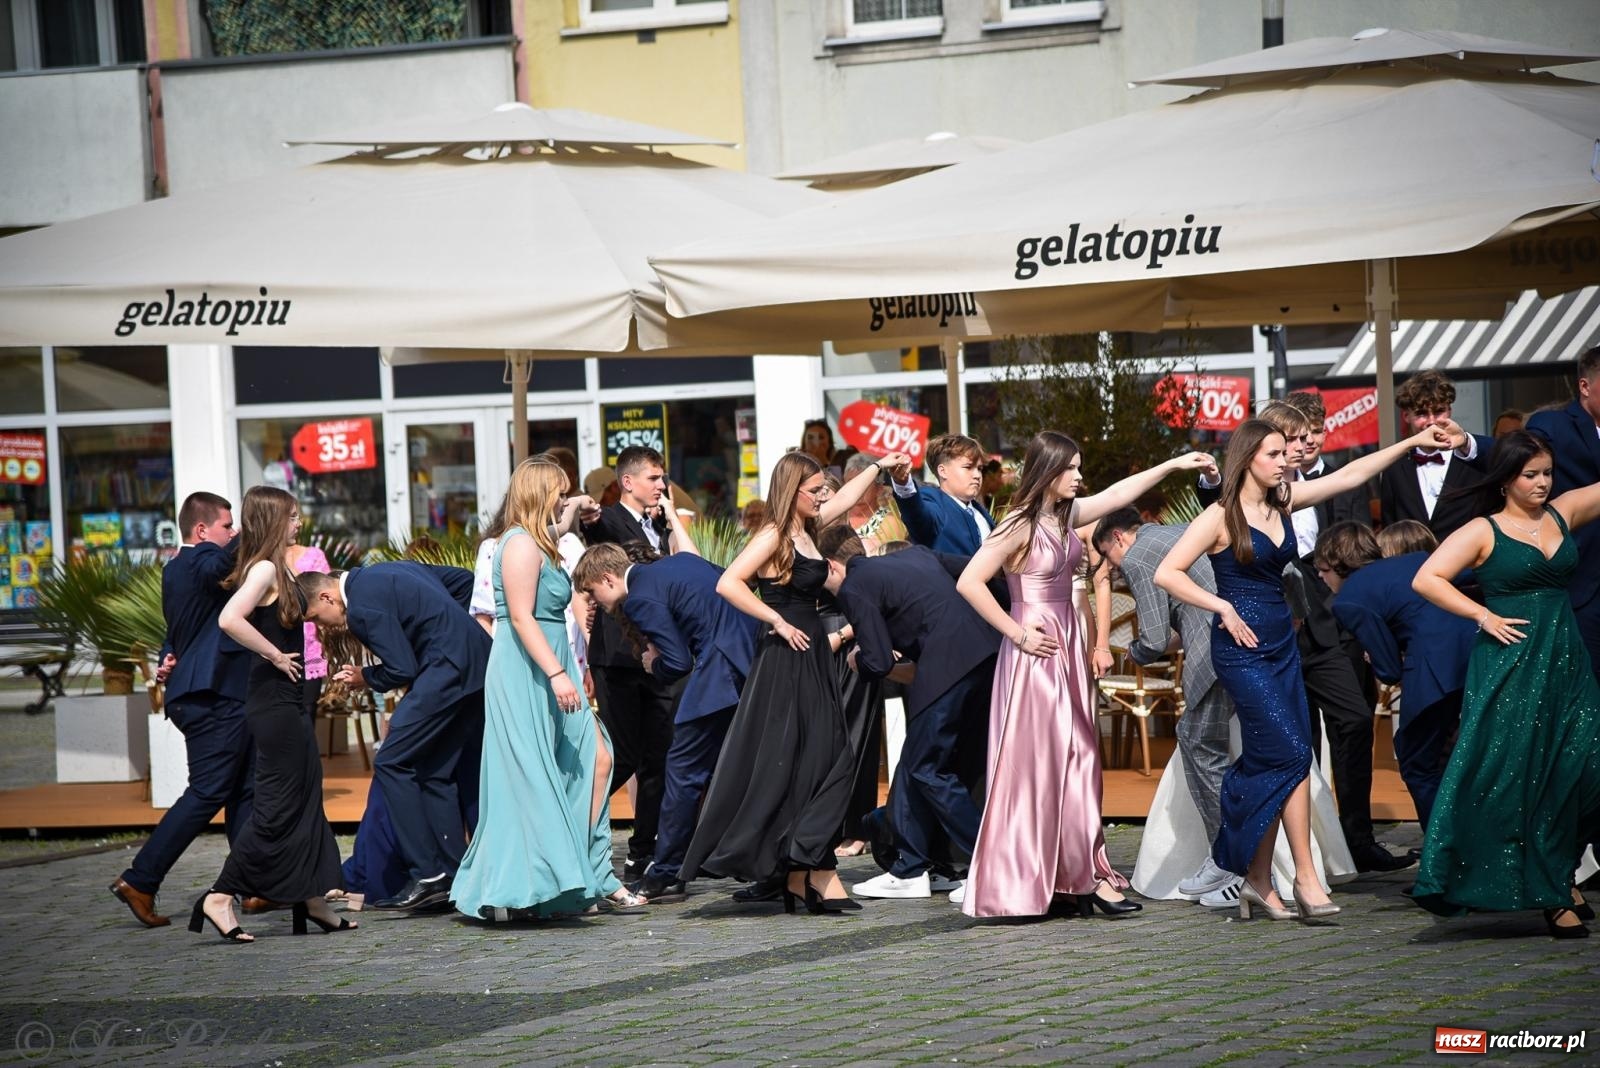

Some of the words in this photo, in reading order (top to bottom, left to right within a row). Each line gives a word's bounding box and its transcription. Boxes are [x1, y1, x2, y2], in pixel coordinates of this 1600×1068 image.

[1014, 214, 1222, 279] gelatopiu
[115, 286, 291, 336] gelatopiu
[623, 408, 644, 418] HITY
[317, 434, 350, 462] 35
[859, 417, 921, 456] -70%
